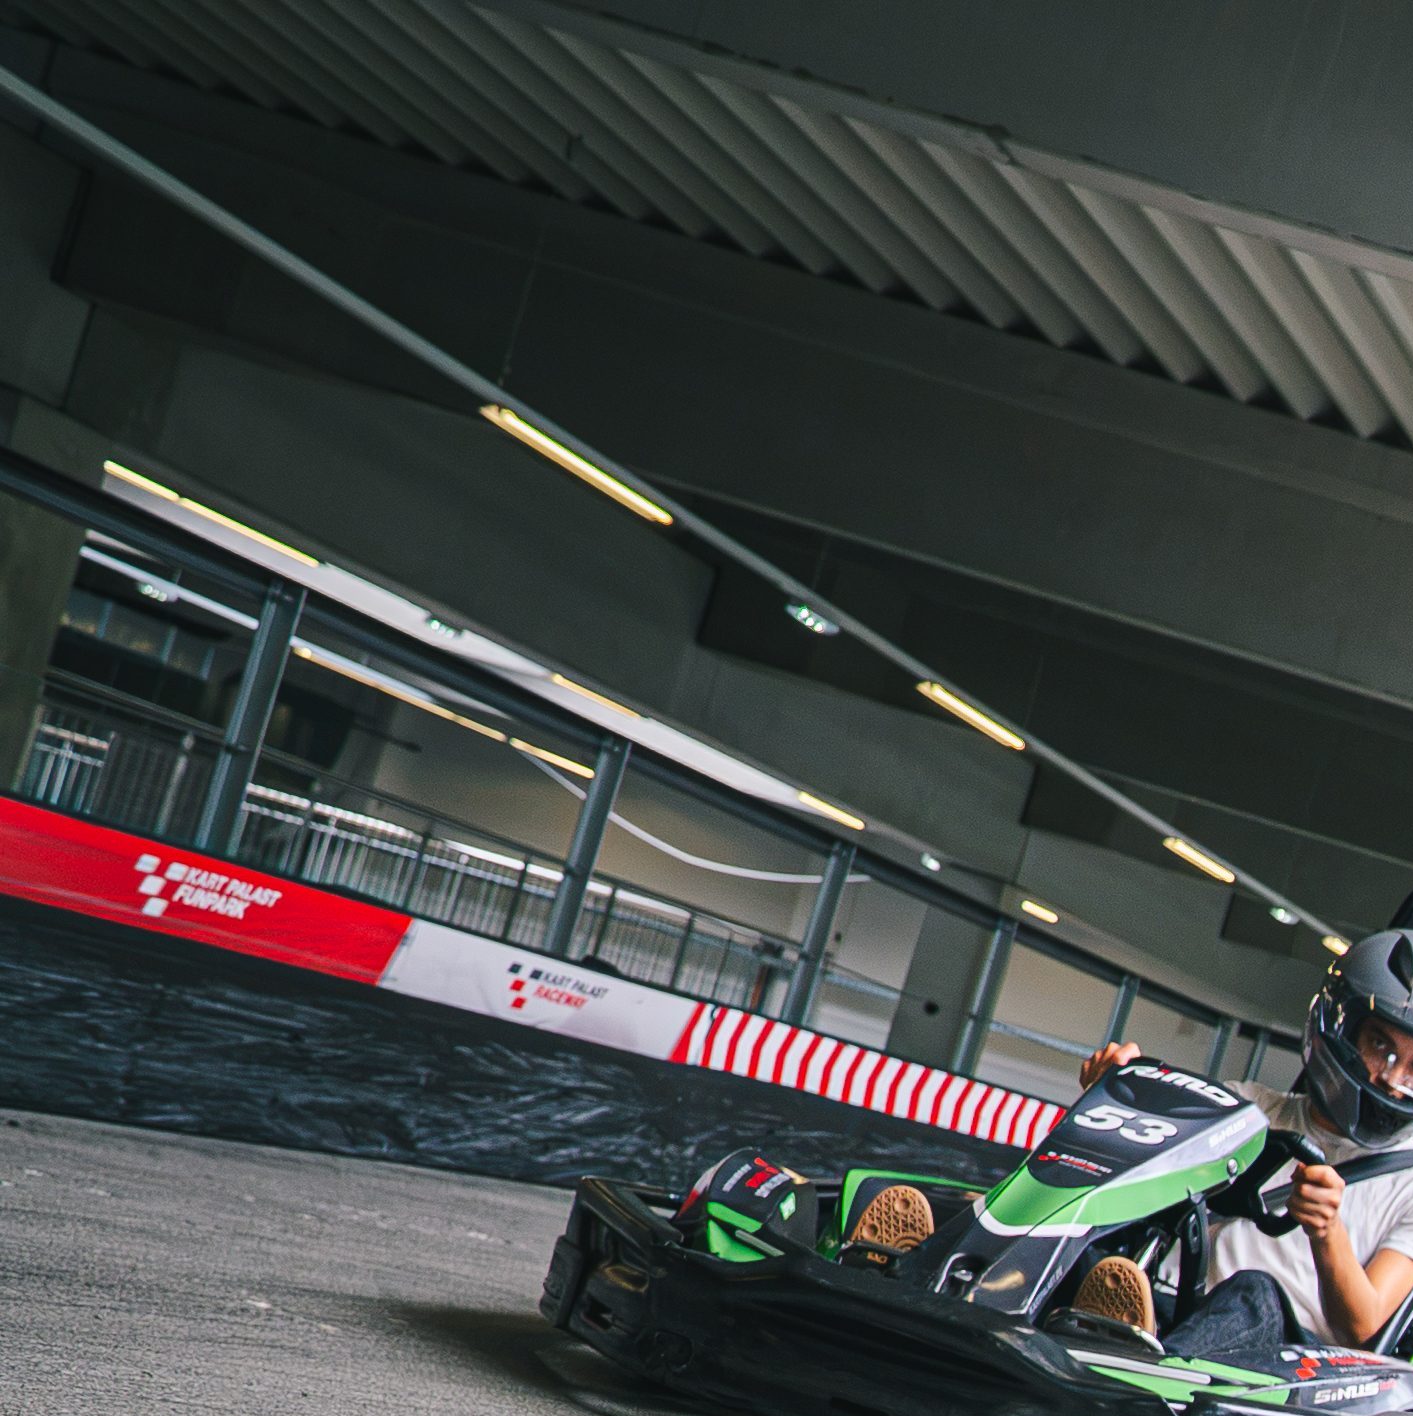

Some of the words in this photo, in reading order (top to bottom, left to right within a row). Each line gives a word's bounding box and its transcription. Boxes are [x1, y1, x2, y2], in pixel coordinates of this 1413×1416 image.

[172, 882, 250, 921] FUNPARK
[184, 866, 230, 892] KART
[224, 877, 283, 909] PALAST
[1073, 1104, 1178, 1145] 53
